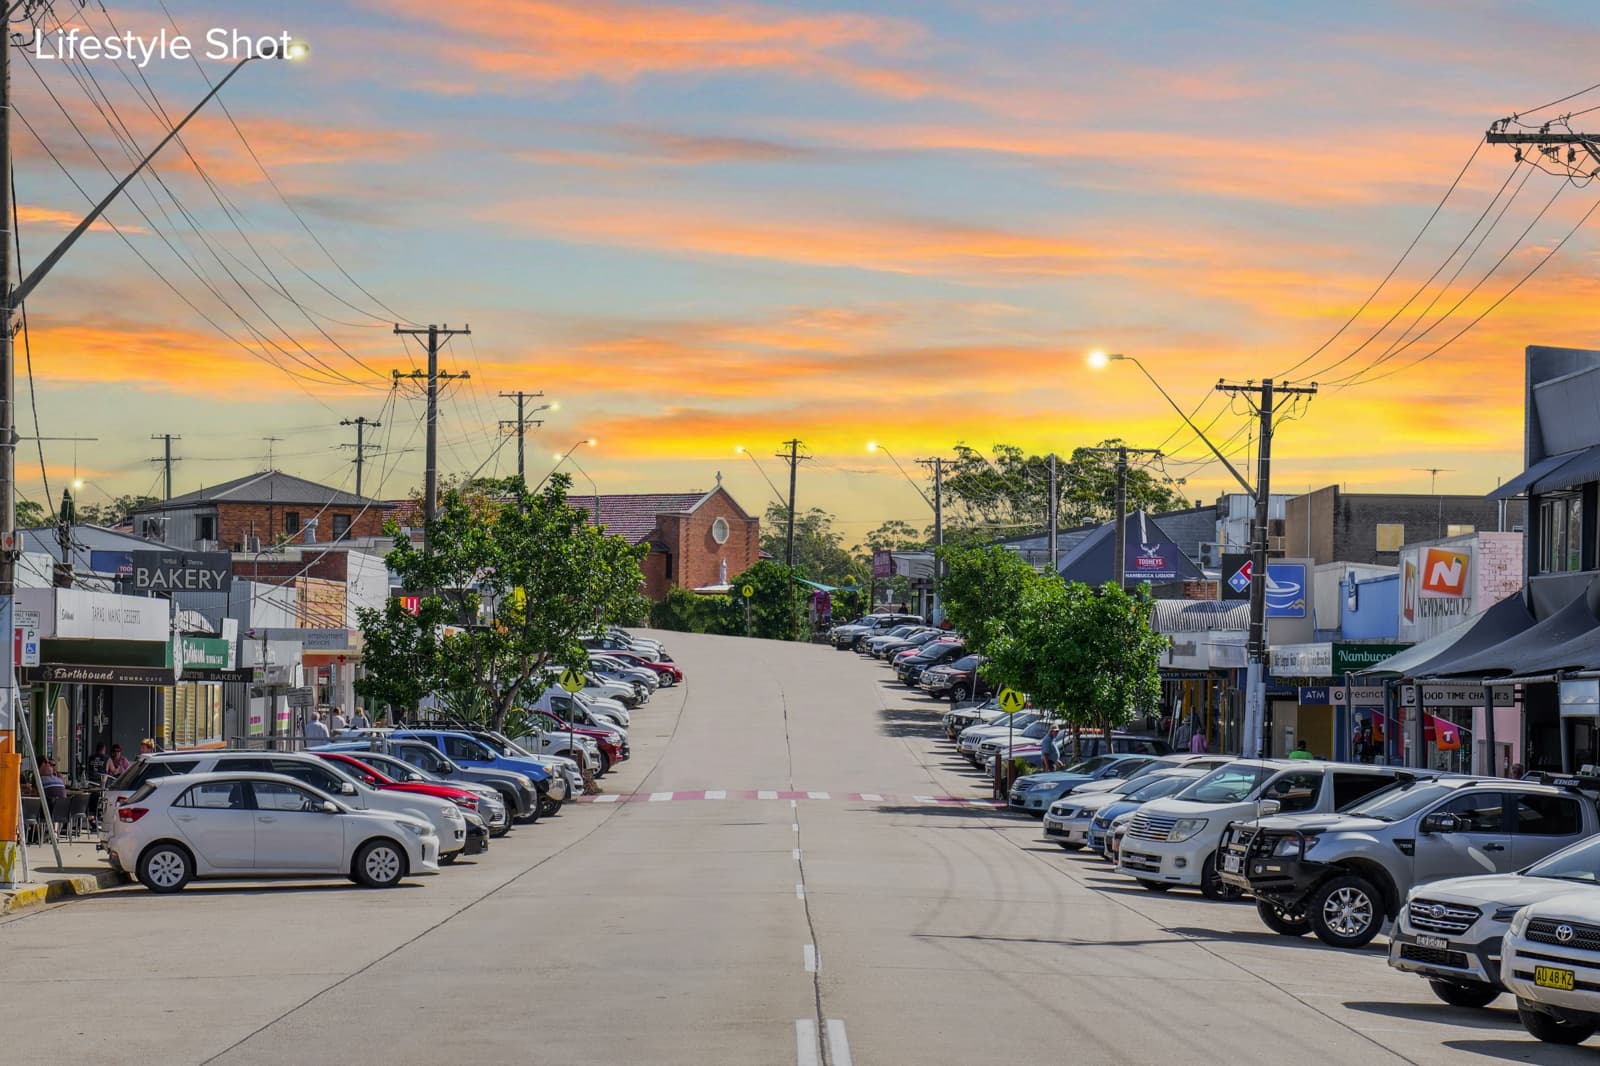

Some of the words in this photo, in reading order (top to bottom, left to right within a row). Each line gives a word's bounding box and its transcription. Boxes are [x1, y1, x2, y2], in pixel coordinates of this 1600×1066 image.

[1429, 557, 1462, 587] N
[136, 567, 227, 590] BAKERY
[27, 630, 35, 640] P
[54, 668, 114, 681] Earthbound
[210, 673, 242, 681] BAKERY
[1305, 691, 1325, 699] ATM
[1344, 690, 1384, 699] recinct
[1423, 691, 1444, 700] OOD
[1446, 691, 1466, 700] TIME
[1553, 778, 1581, 786] KINGS
[1536, 970, 1547, 983] AU
[1561, 973, 1573, 987] KZ
